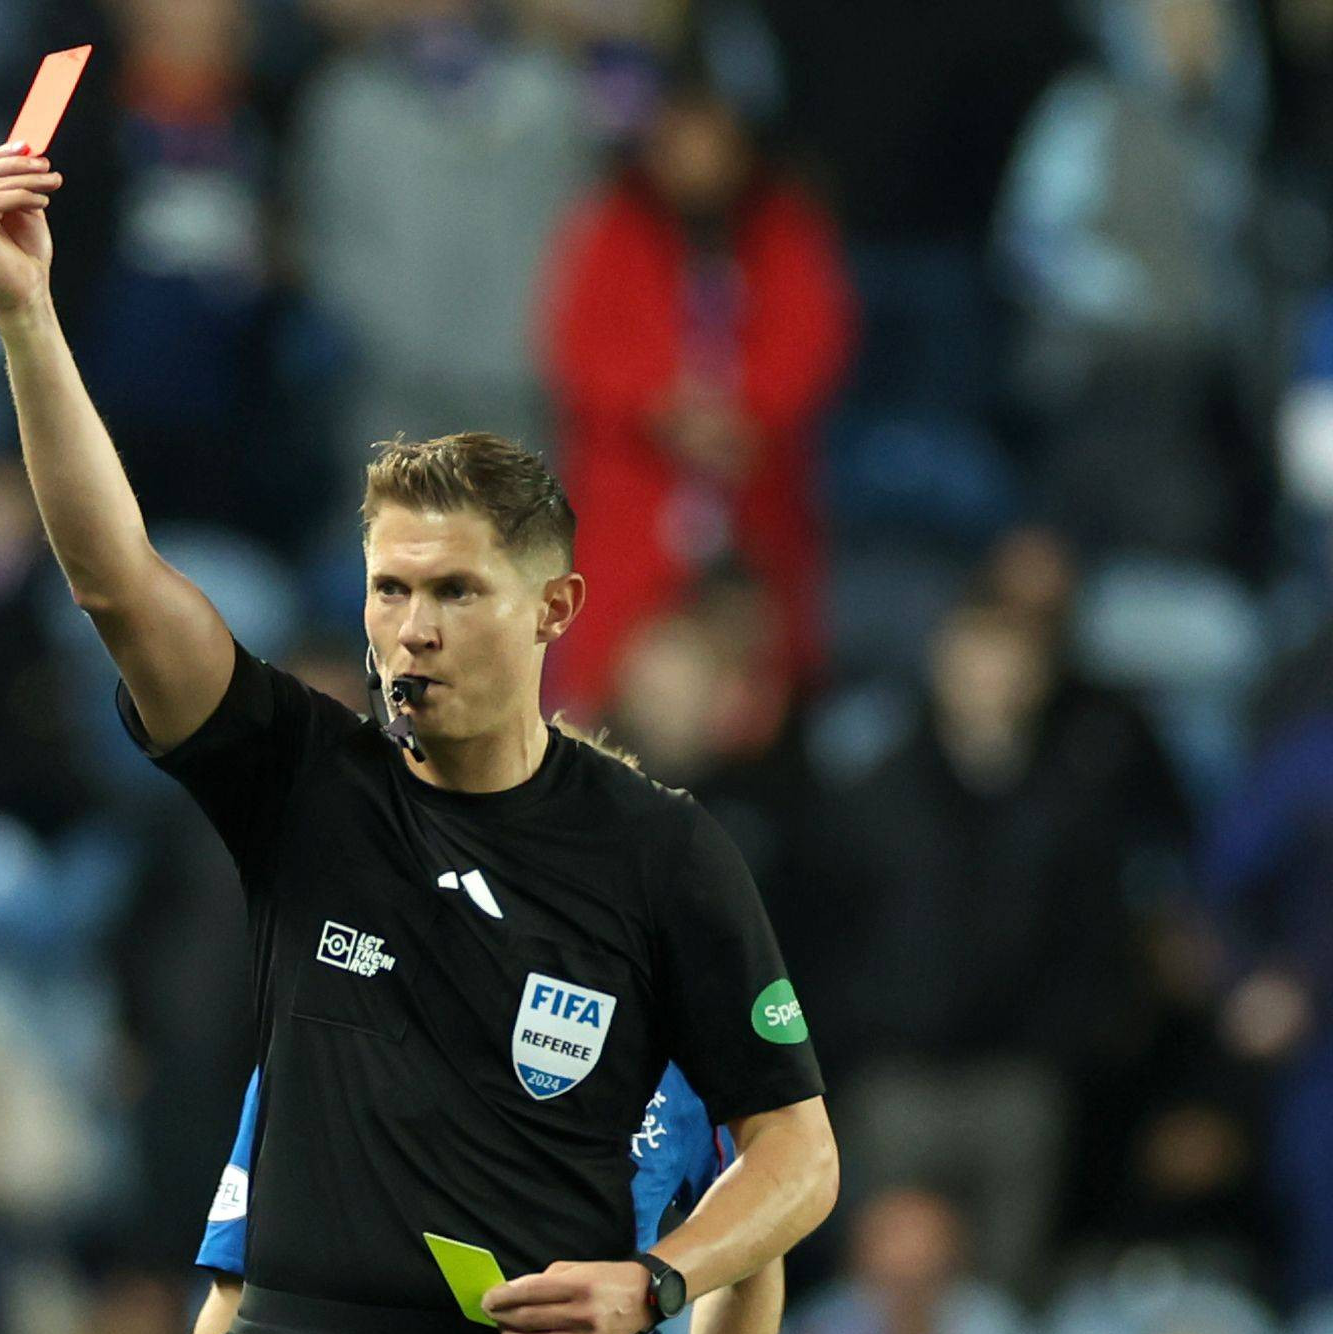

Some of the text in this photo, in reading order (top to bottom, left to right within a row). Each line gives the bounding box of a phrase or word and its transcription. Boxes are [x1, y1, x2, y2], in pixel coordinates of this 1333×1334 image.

[530, 983, 601, 1029] FIFA
[521, 1029, 592, 1062] REFEREE
[527, 1071, 561, 1091] 2024
